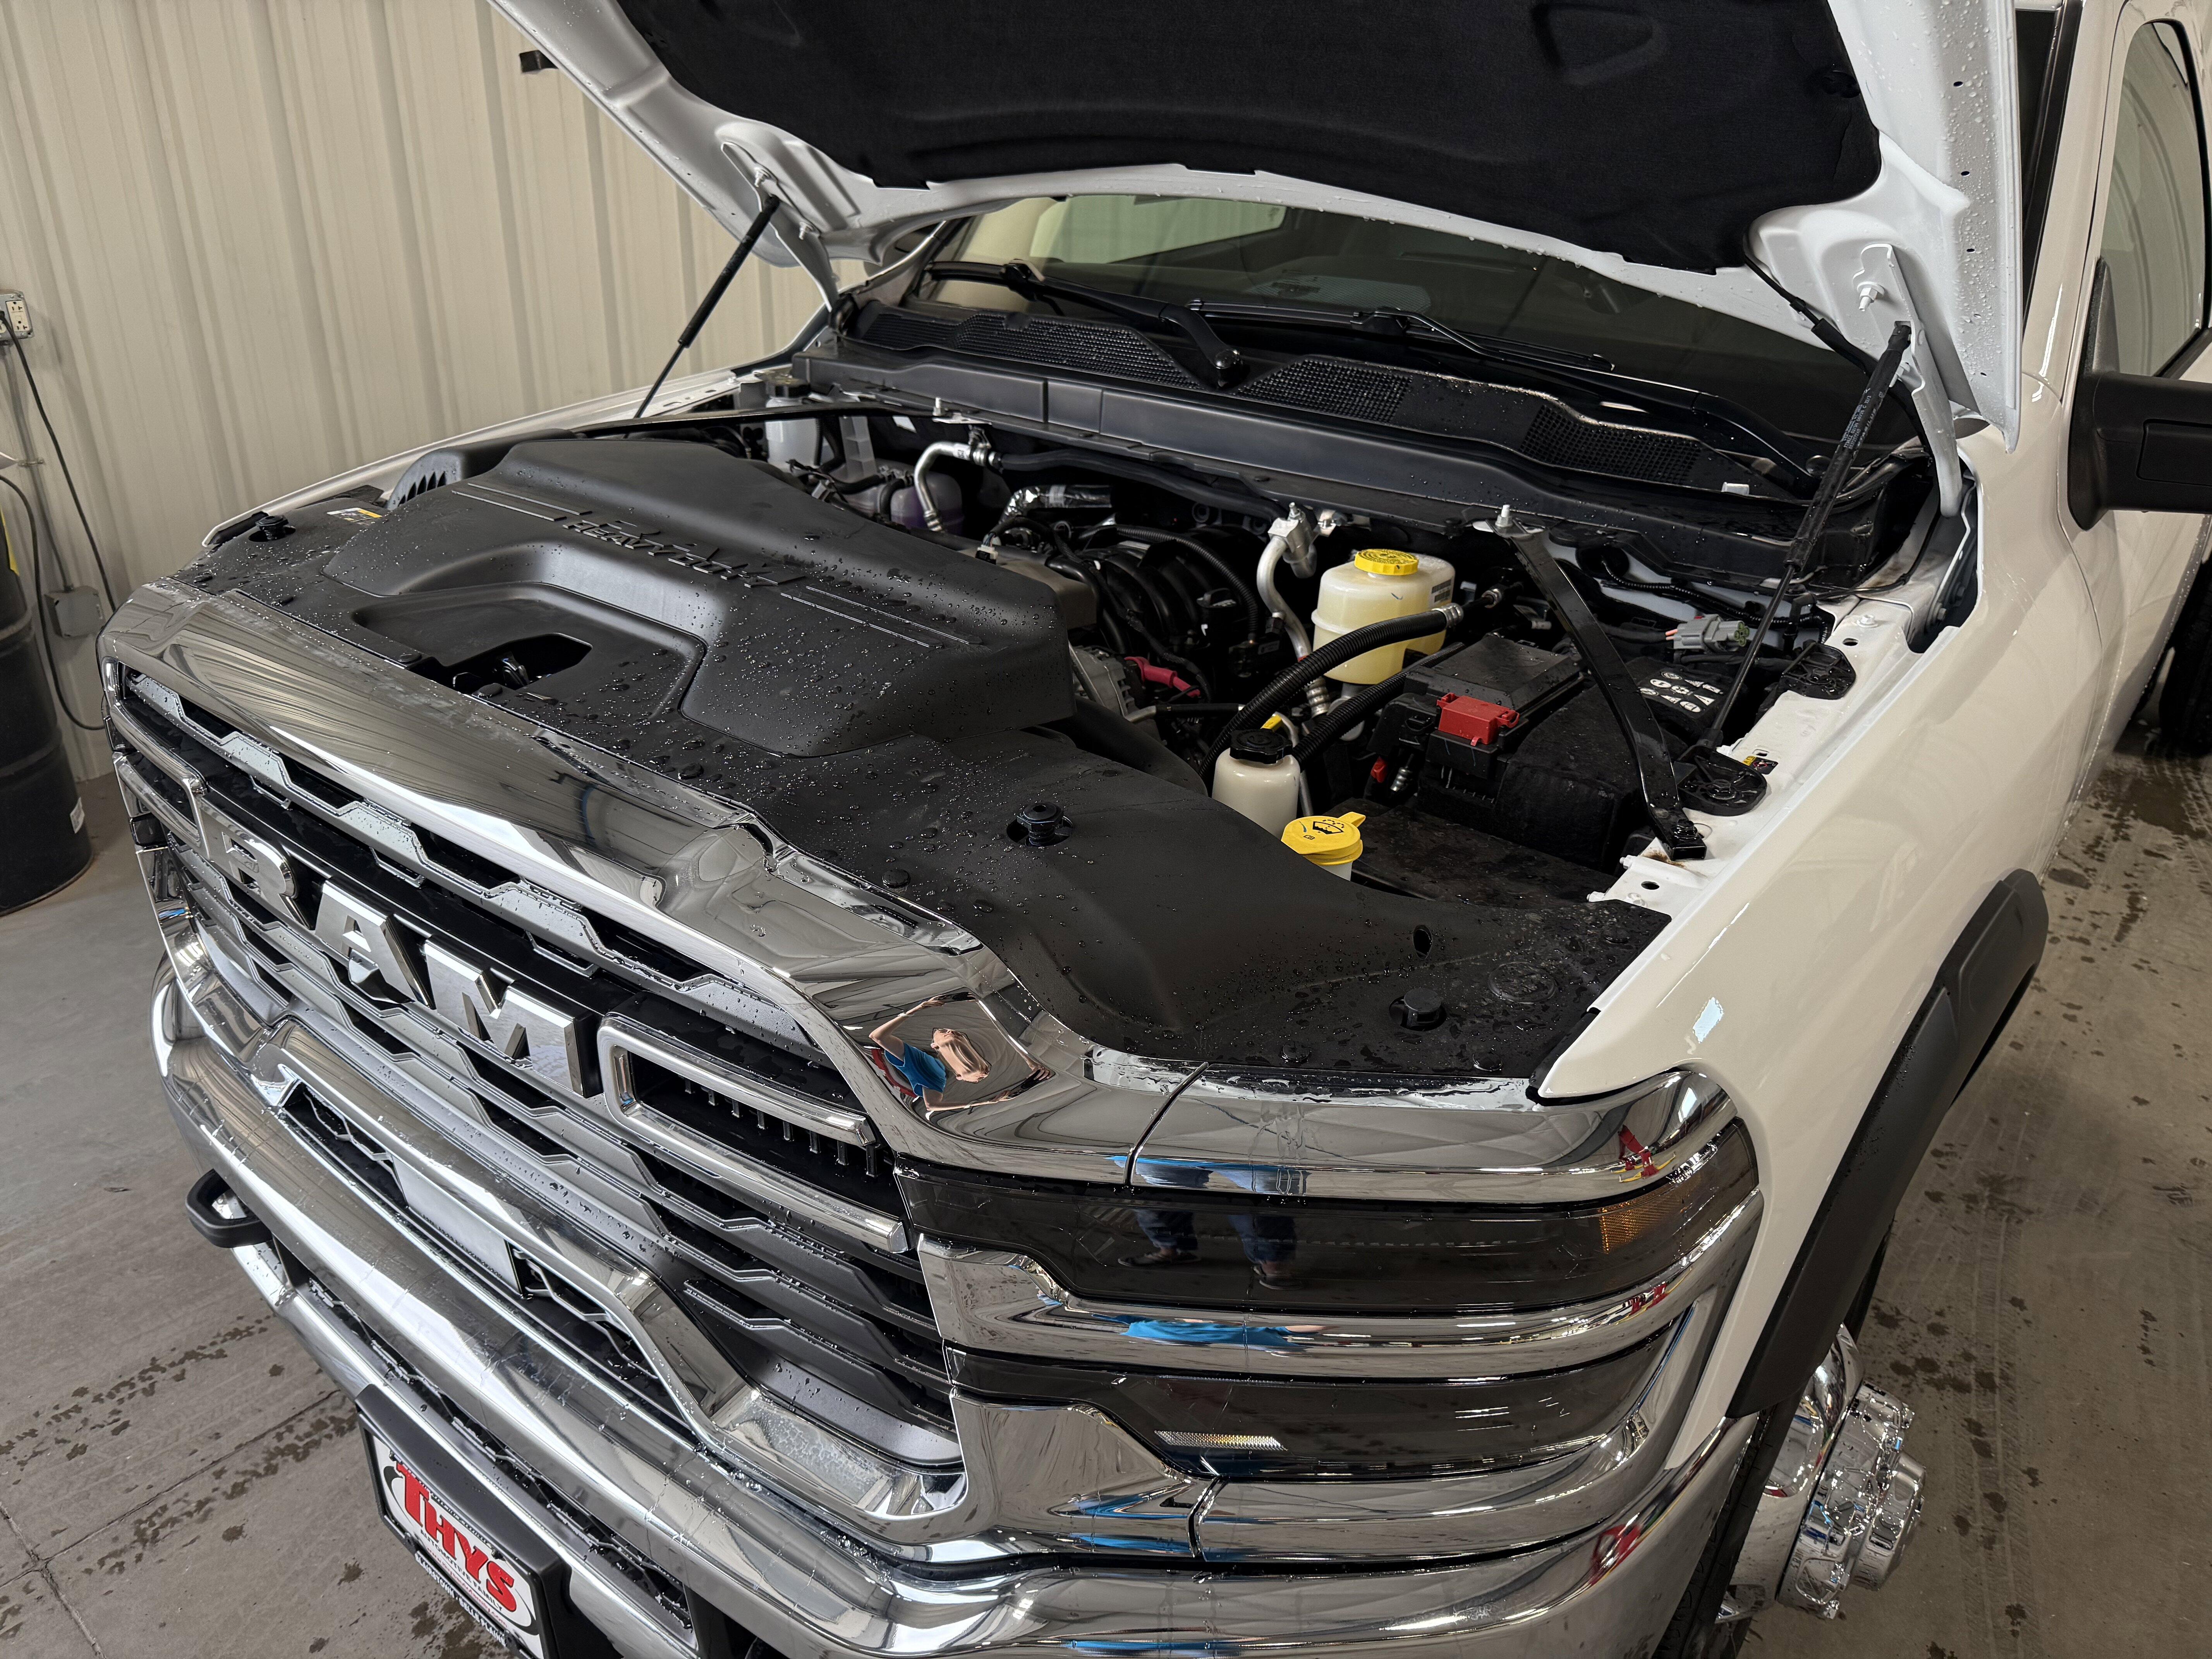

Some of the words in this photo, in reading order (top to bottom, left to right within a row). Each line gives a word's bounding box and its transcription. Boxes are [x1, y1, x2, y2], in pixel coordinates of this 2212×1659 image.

[562, 521, 677, 556] HEAVY
[667, 553, 777, 588] DUTY
[202, 796, 585, 1097] RAM
[395, 1462, 517, 1613] THYS
[420, 1528, 472, 1583] AUTOMOTIVE
[473, 1581, 503, 1611] FAMILY
